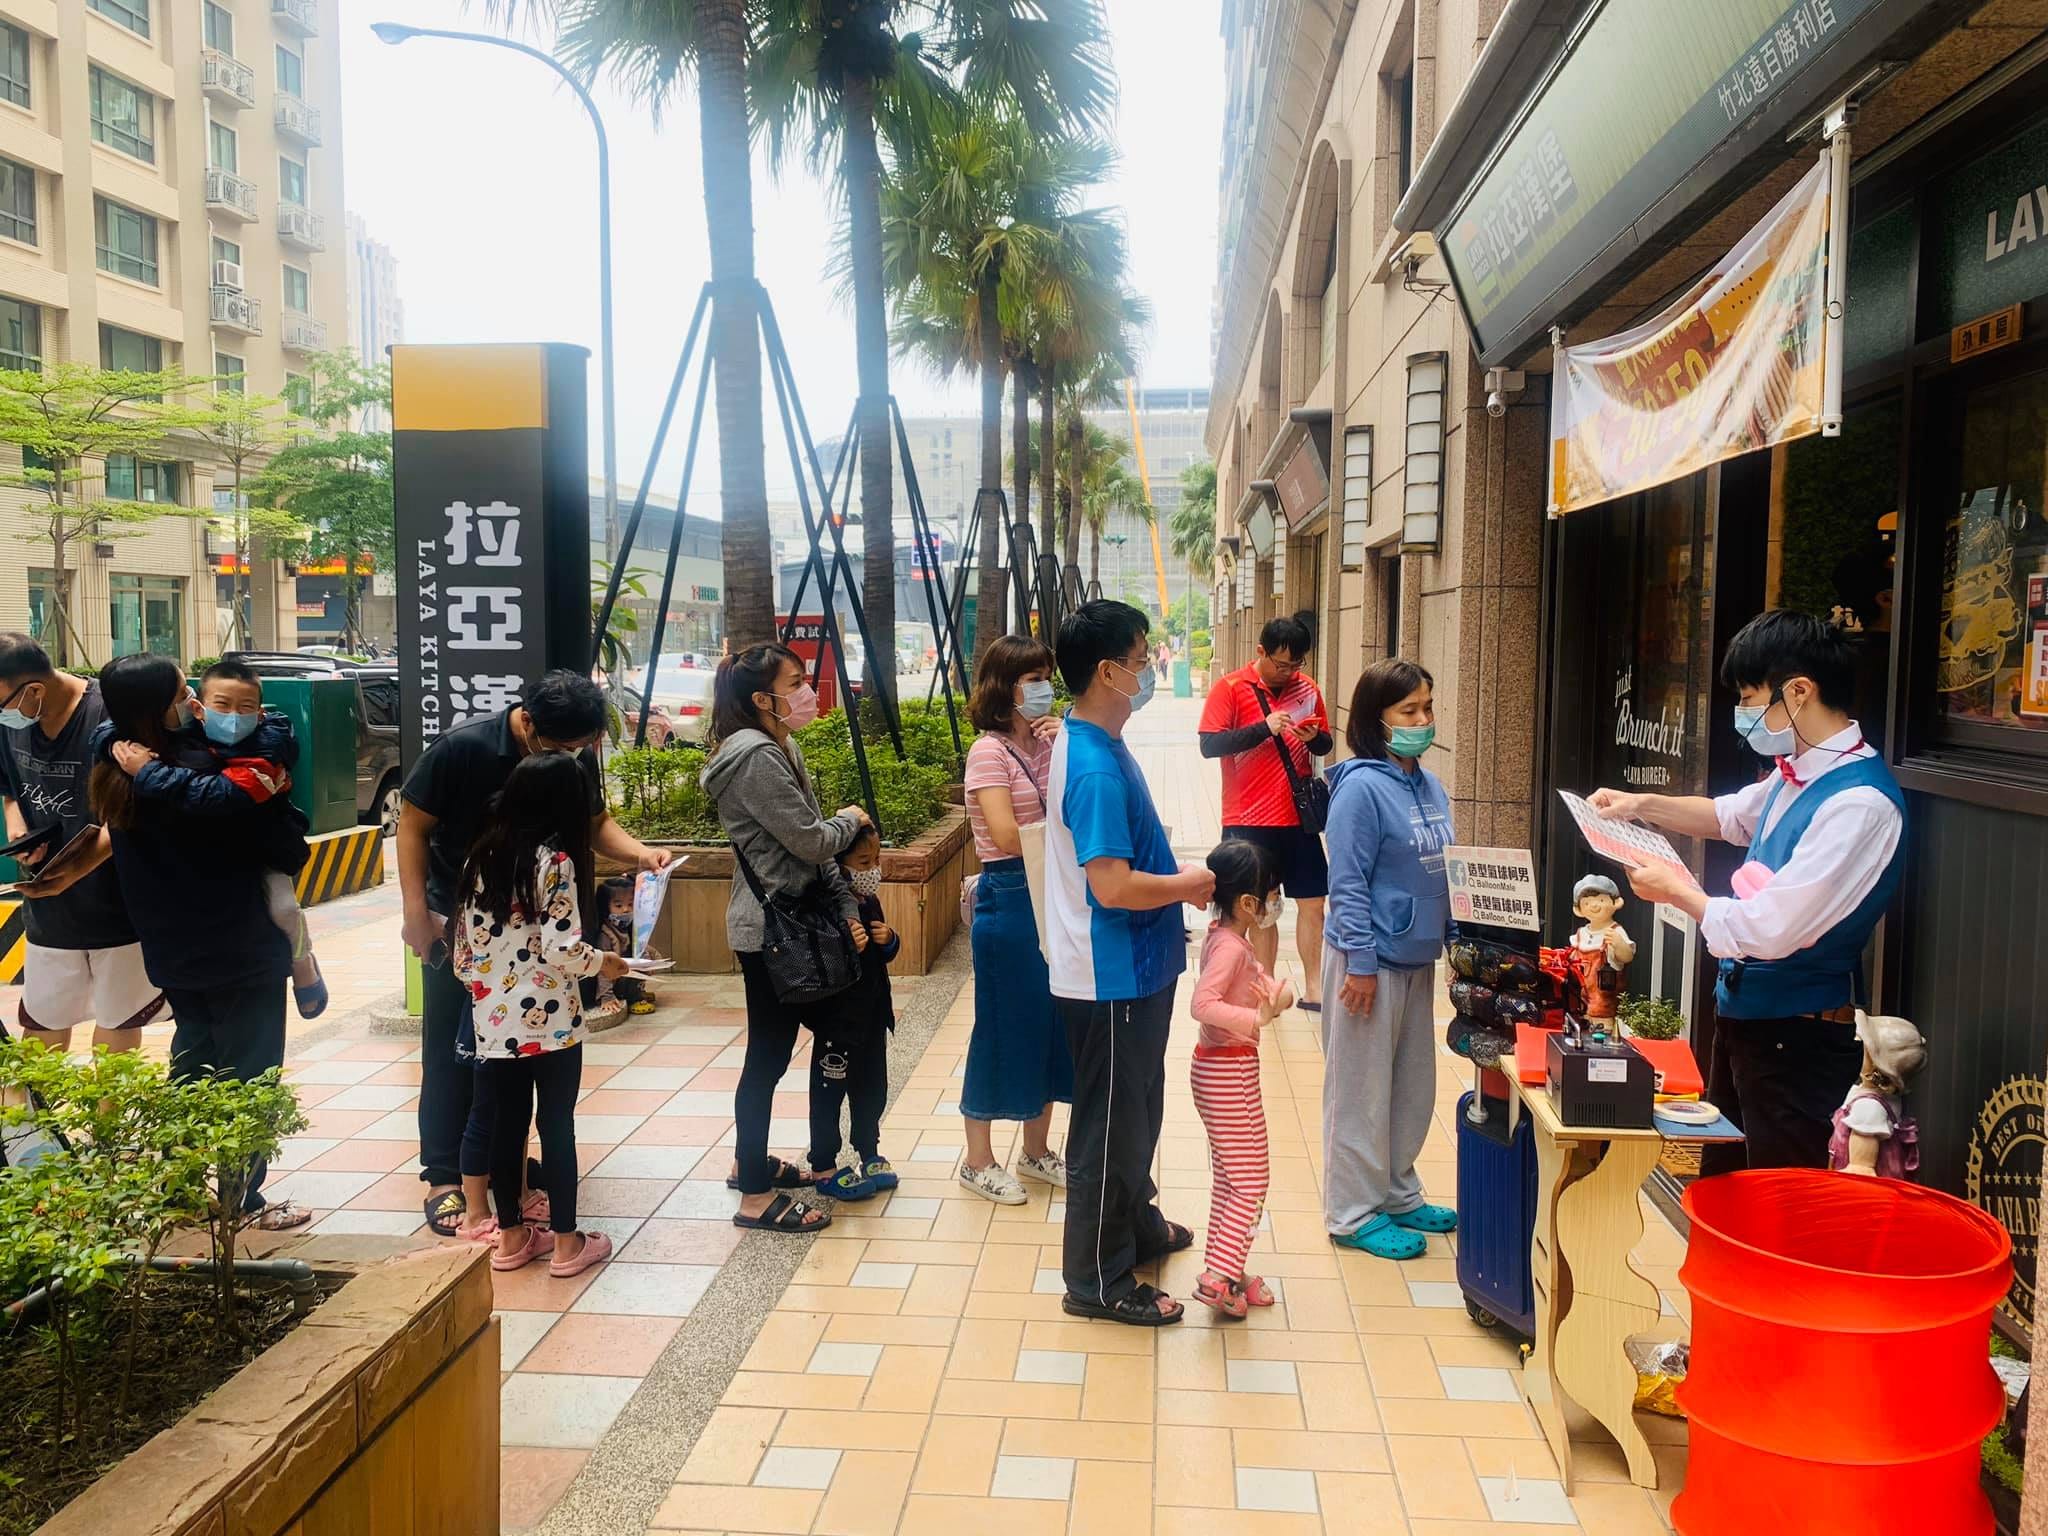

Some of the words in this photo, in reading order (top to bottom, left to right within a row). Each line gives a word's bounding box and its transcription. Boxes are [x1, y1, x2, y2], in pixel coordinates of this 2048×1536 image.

[1482, 129, 1574, 266] 拉亞漢堡
[417, 539, 438, 622] LAYA
[1614, 663, 1632, 708] just
[1615, 698, 1668, 755] Brunch
[1668, 706, 1685, 758] it
[1627, 764, 1641, 785] LAYA
[1641, 765, 1667, 786] BURGER
[1467, 861, 1530, 883] 造型氣球柯男
[1472, 893, 1533, 916] 造型氣球柯男
